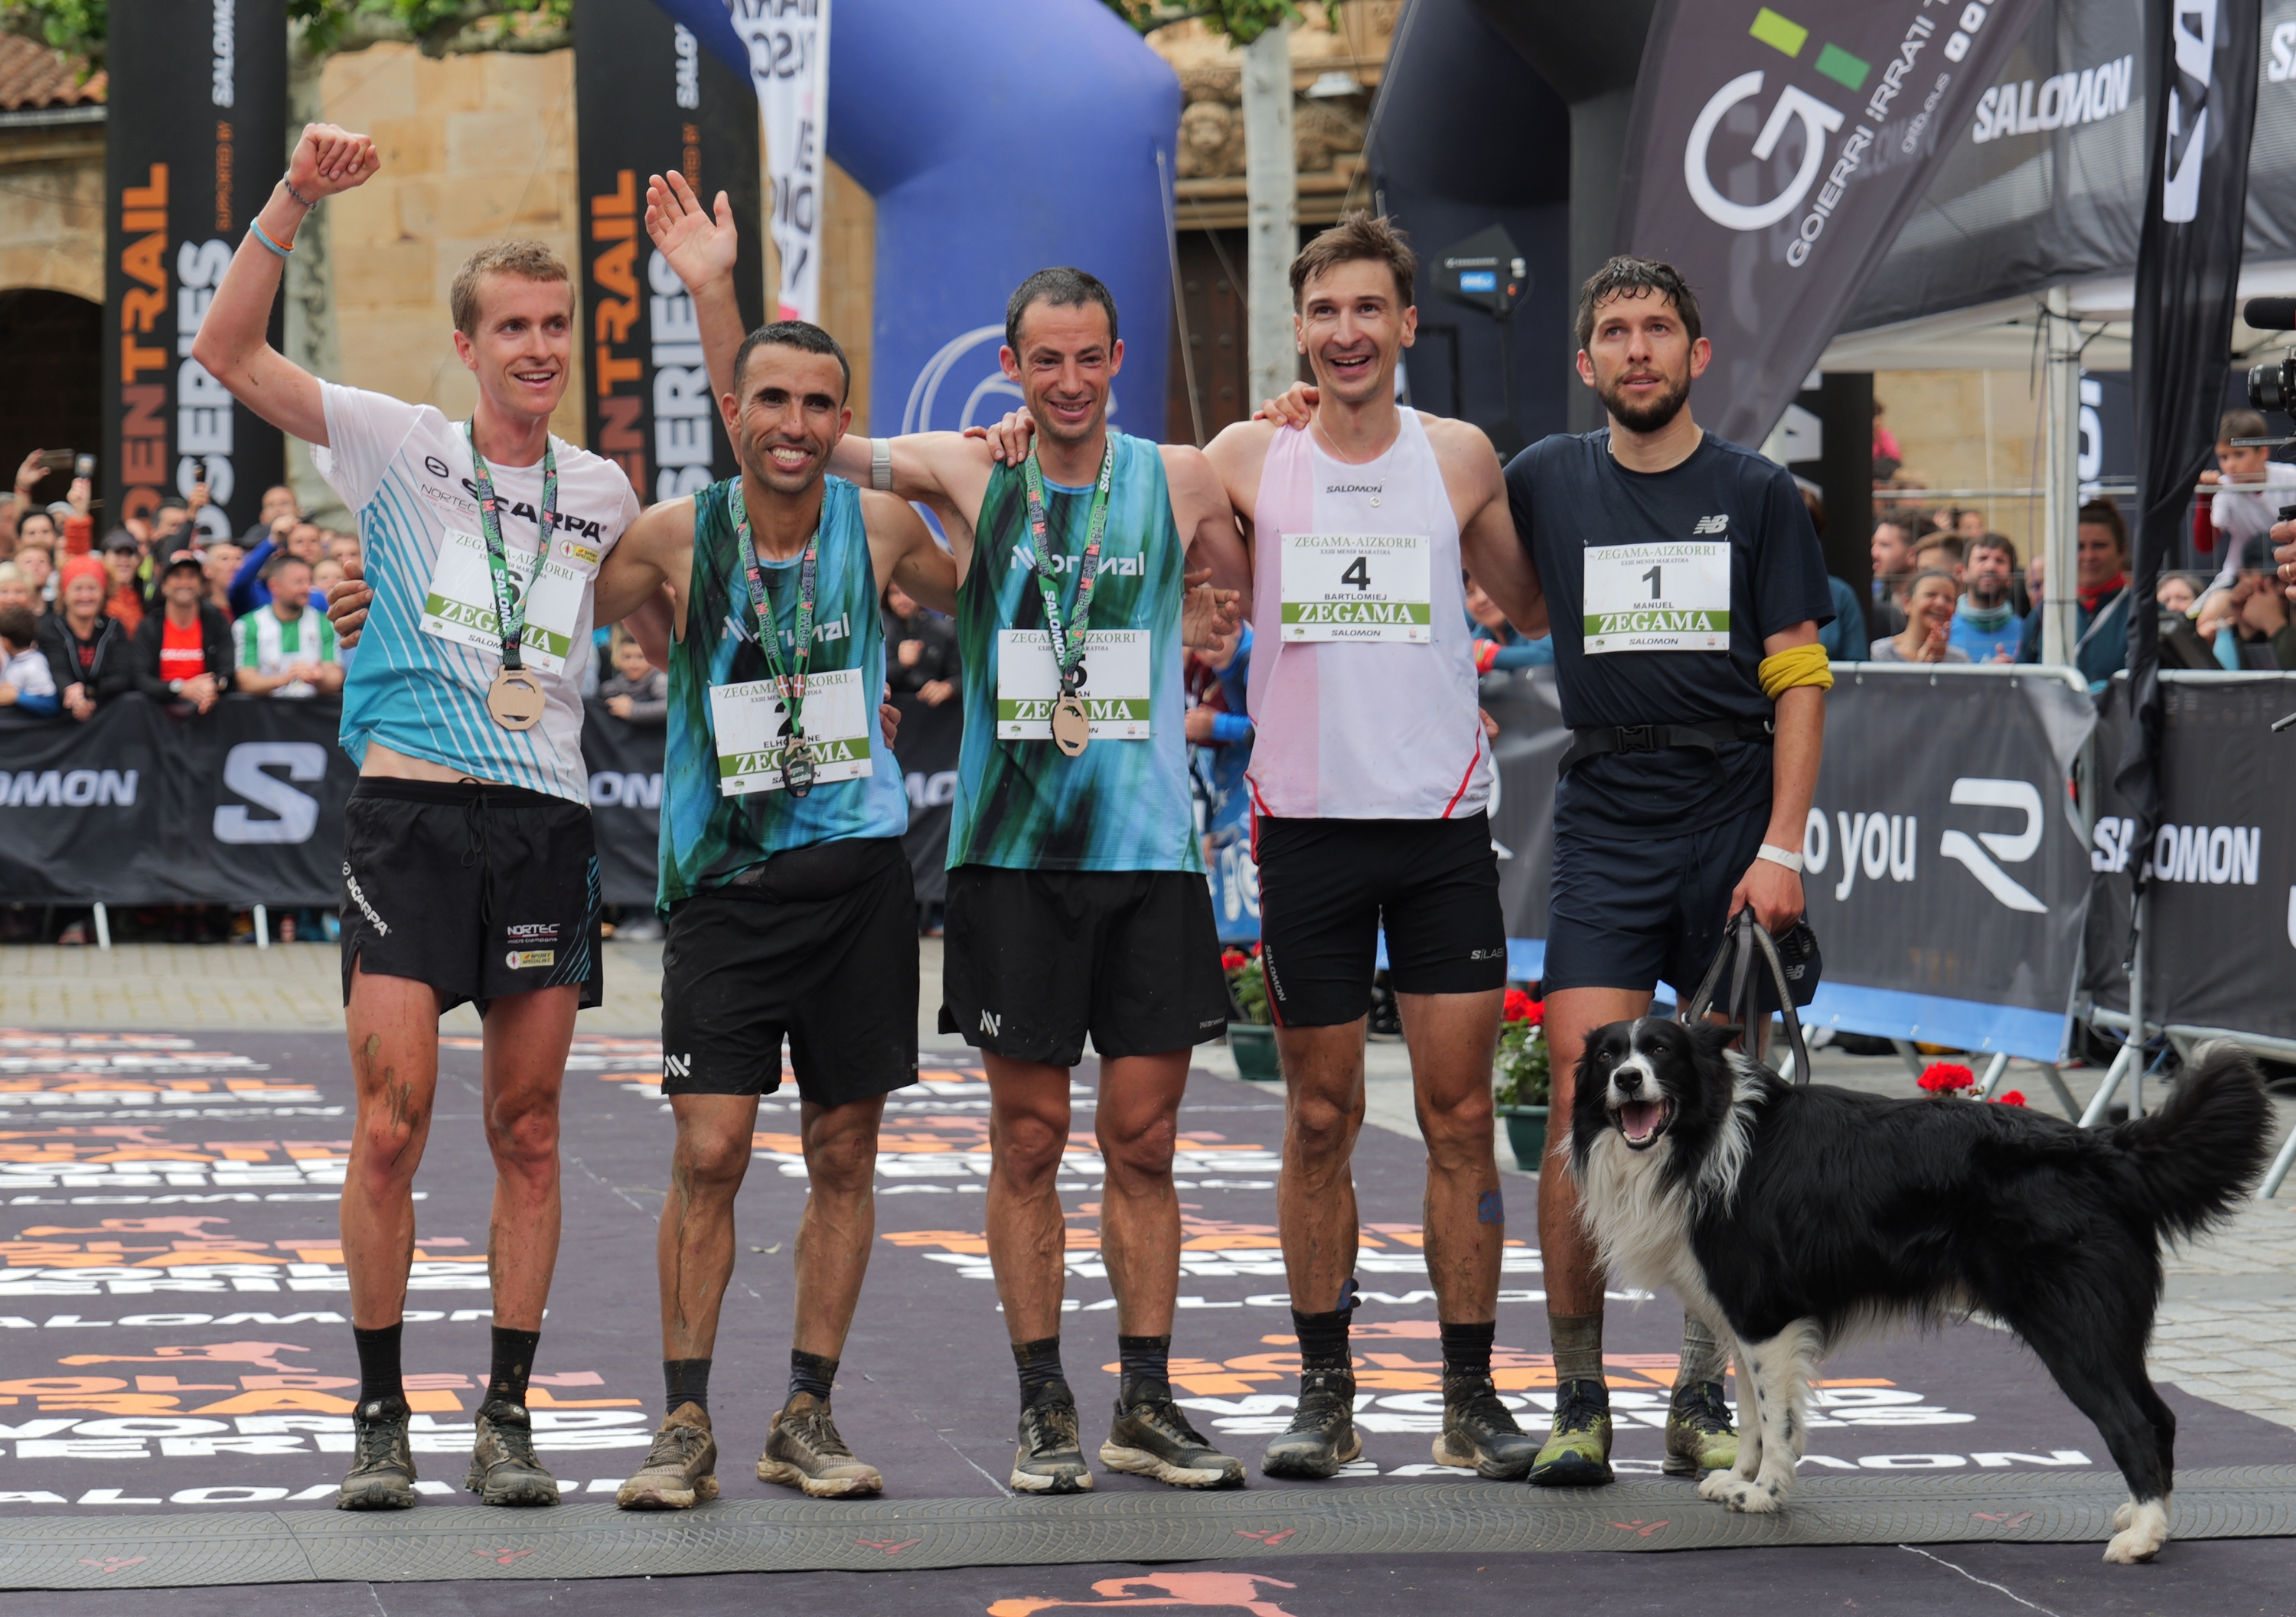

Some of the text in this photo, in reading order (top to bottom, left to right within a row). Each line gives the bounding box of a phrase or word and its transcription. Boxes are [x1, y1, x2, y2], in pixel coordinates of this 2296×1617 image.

[1971, 54, 2133, 144] SALOMON
[1786, 125, 1875, 268] GOIERRI
[121, 162, 168, 383] TRAIL
[591, 168, 644, 396] TRAIL
[421, 483, 479, 514] NORTEC
[1326, 484, 1382, 494] SALOMON
[1029, 491, 1044, 524] MENDI
[1087, 504, 1107, 556] MARATOIA
[1294, 536, 1417, 548] ZEGAMA-AIZKORRI
[1032, 522, 1052, 576] MARATOIA
[1597, 545, 1717, 561] ZEGAMA-AIZKORRI
[746, 568, 765, 603] MENDI
[1080, 554, 1099, 590] MENDI
[1341, 556, 1371, 591] 4
[1642, 566, 1662, 600] 1
[438, 598, 552, 654] ZEGMA
[755, 601, 779, 659] MARATOIA
[1297, 603, 1415, 624] ZEGAMA
[1599, 611, 1714, 634] ZEGAMA
[797, 611, 810, 657] ZEGAMA
[1011, 632, 1137, 644] ZEGAIZKORRI
[723, 673, 849, 698] ZEGAMAKORRI
[1014, 699, 1133, 720] ZEMA
[735, 741, 854, 775] ZEGMA
[1835, 811, 1916, 901] you
[2090, 816, 2262, 885] SAOMON
[347, 875, 387, 937] SCARPA
[507, 923, 561, 936] NORTEC
[1265, 944, 1287, 1002] SALOMON
[0, 1387, 642, 1415] RAIL
[0, 1427, 655, 1459] ERIES
